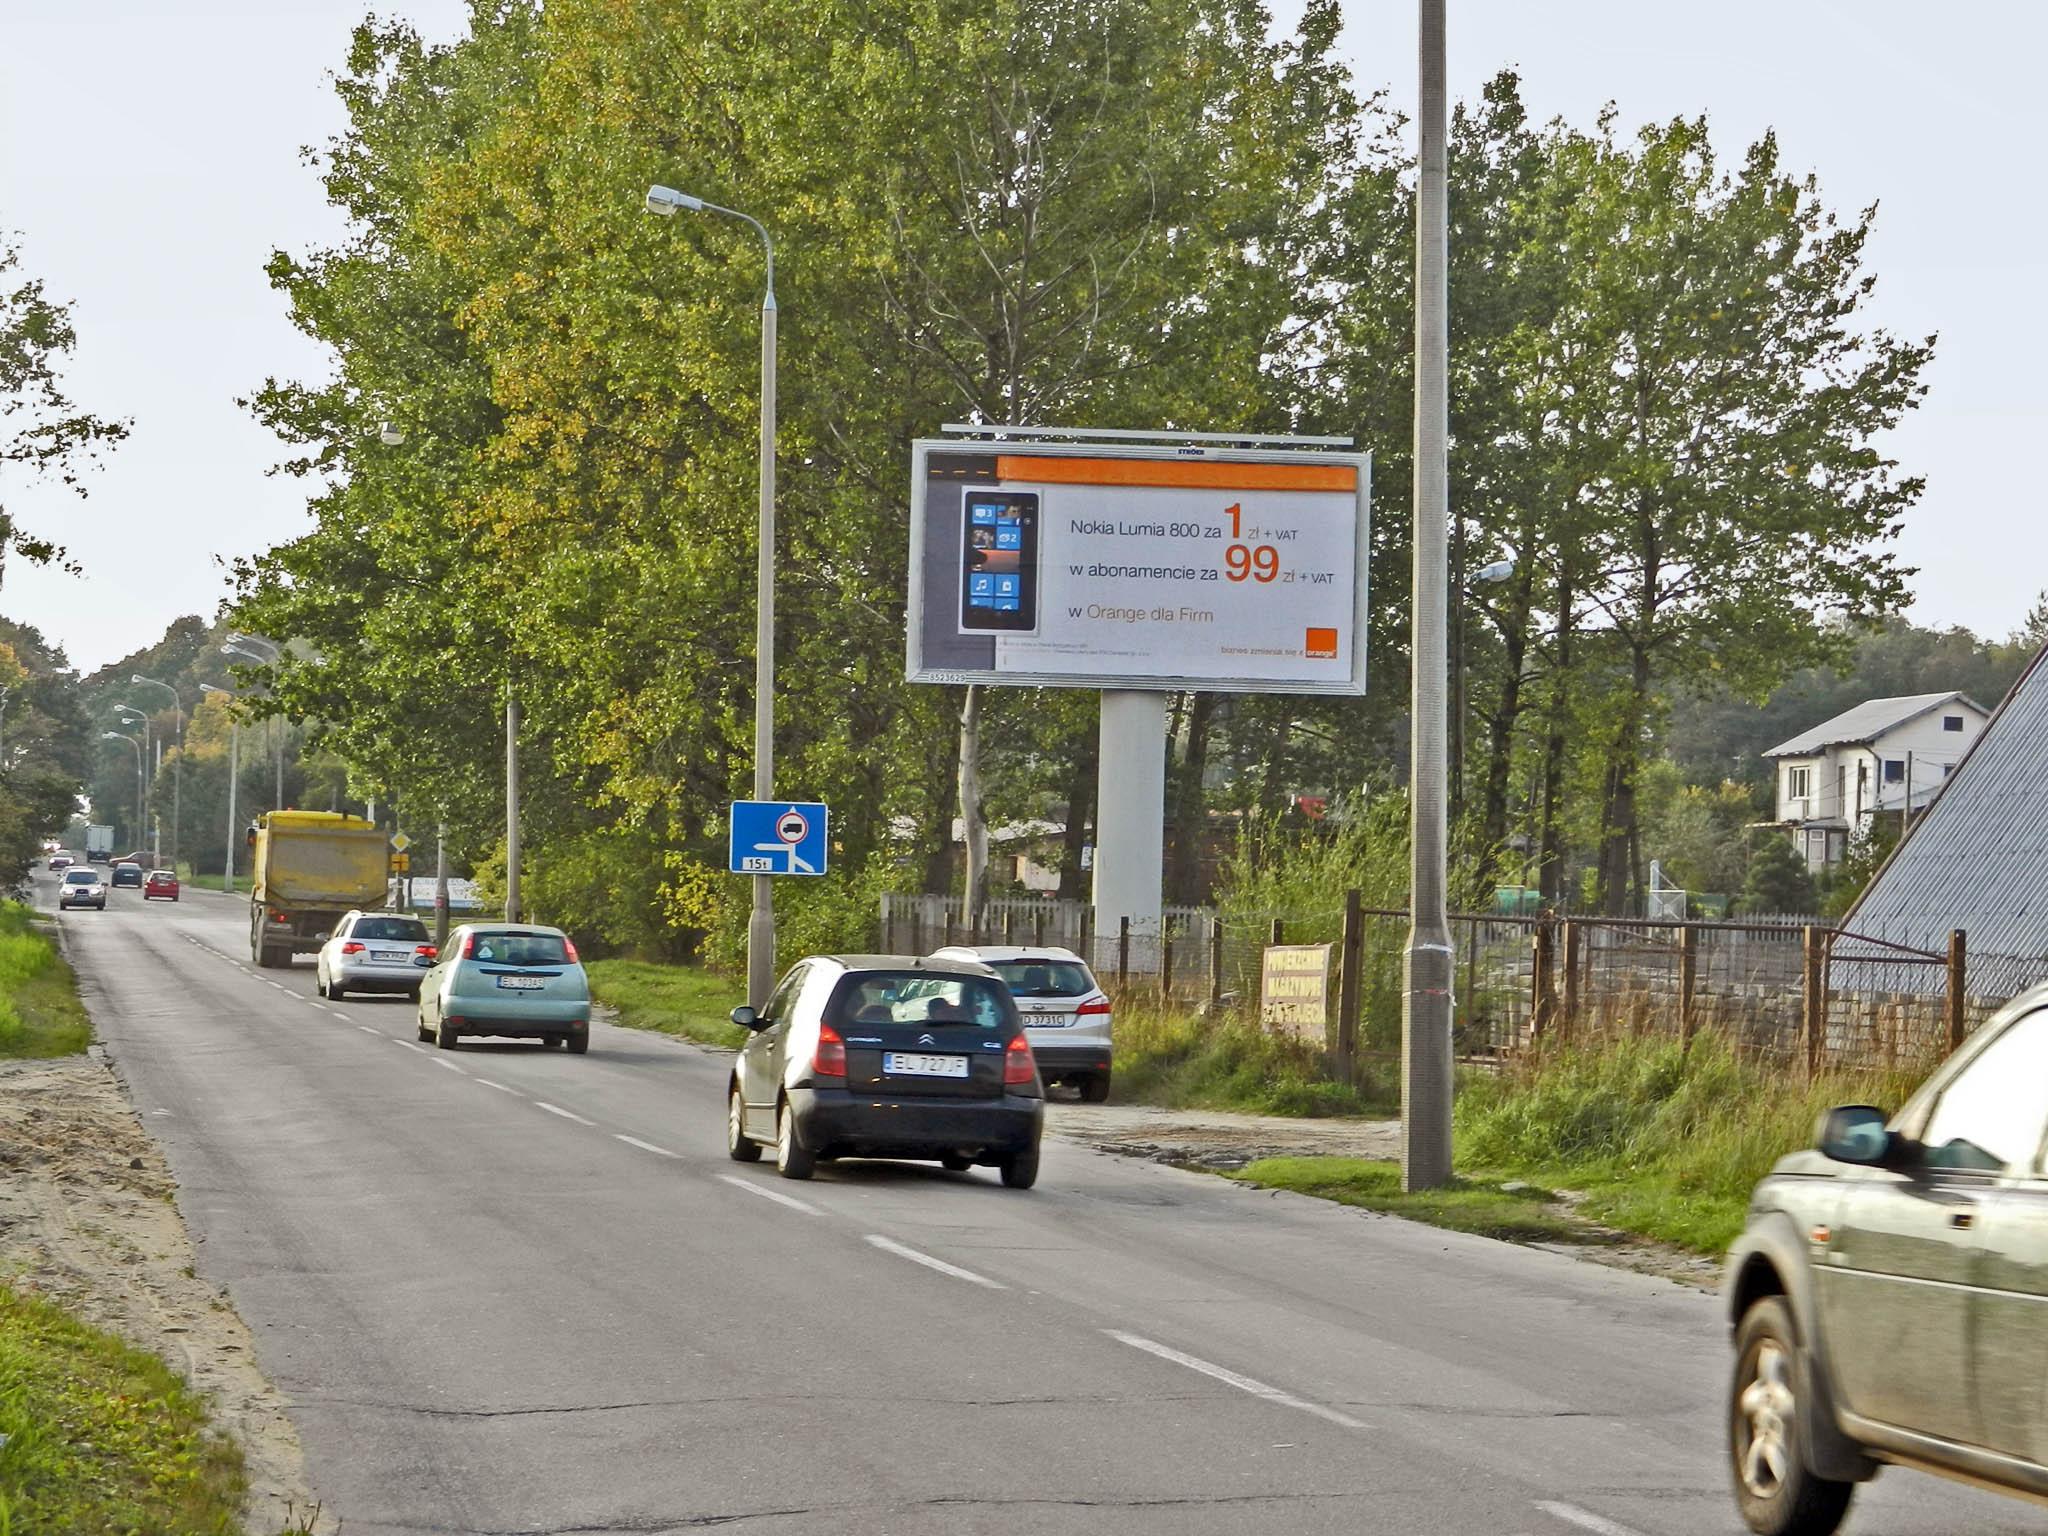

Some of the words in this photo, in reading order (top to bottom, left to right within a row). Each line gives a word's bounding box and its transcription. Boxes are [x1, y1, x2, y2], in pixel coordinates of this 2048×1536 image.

[1071, 520, 1114, 535] Nokia
[1119, 522, 1165, 536] Lumia
[1170, 523, 1200, 538] 800
[1203, 527, 1221, 538] za
[1224, 503, 1241, 539] 1
[1248, 527, 1260, 540] zł
[1276, 530, 1298, 541] VAT
[1070, 565, 1084, 576] w
[1088, 563, 1195, 579] abonamencie
[1200, 569, 1218, 580] za
[1225, 544, 1280, 583] 99
[1283, 569, 1295, 583] zł
[1312, 573, 1334, 584] VAT
[1068, 607, 1082, 618] w
[1087, 604, 1145, 623] Orange
[1151, 607, 1173, 621] dla
[1180, 608, 1213, 622] Firm
[1307, 650, 1335, 658] orange
